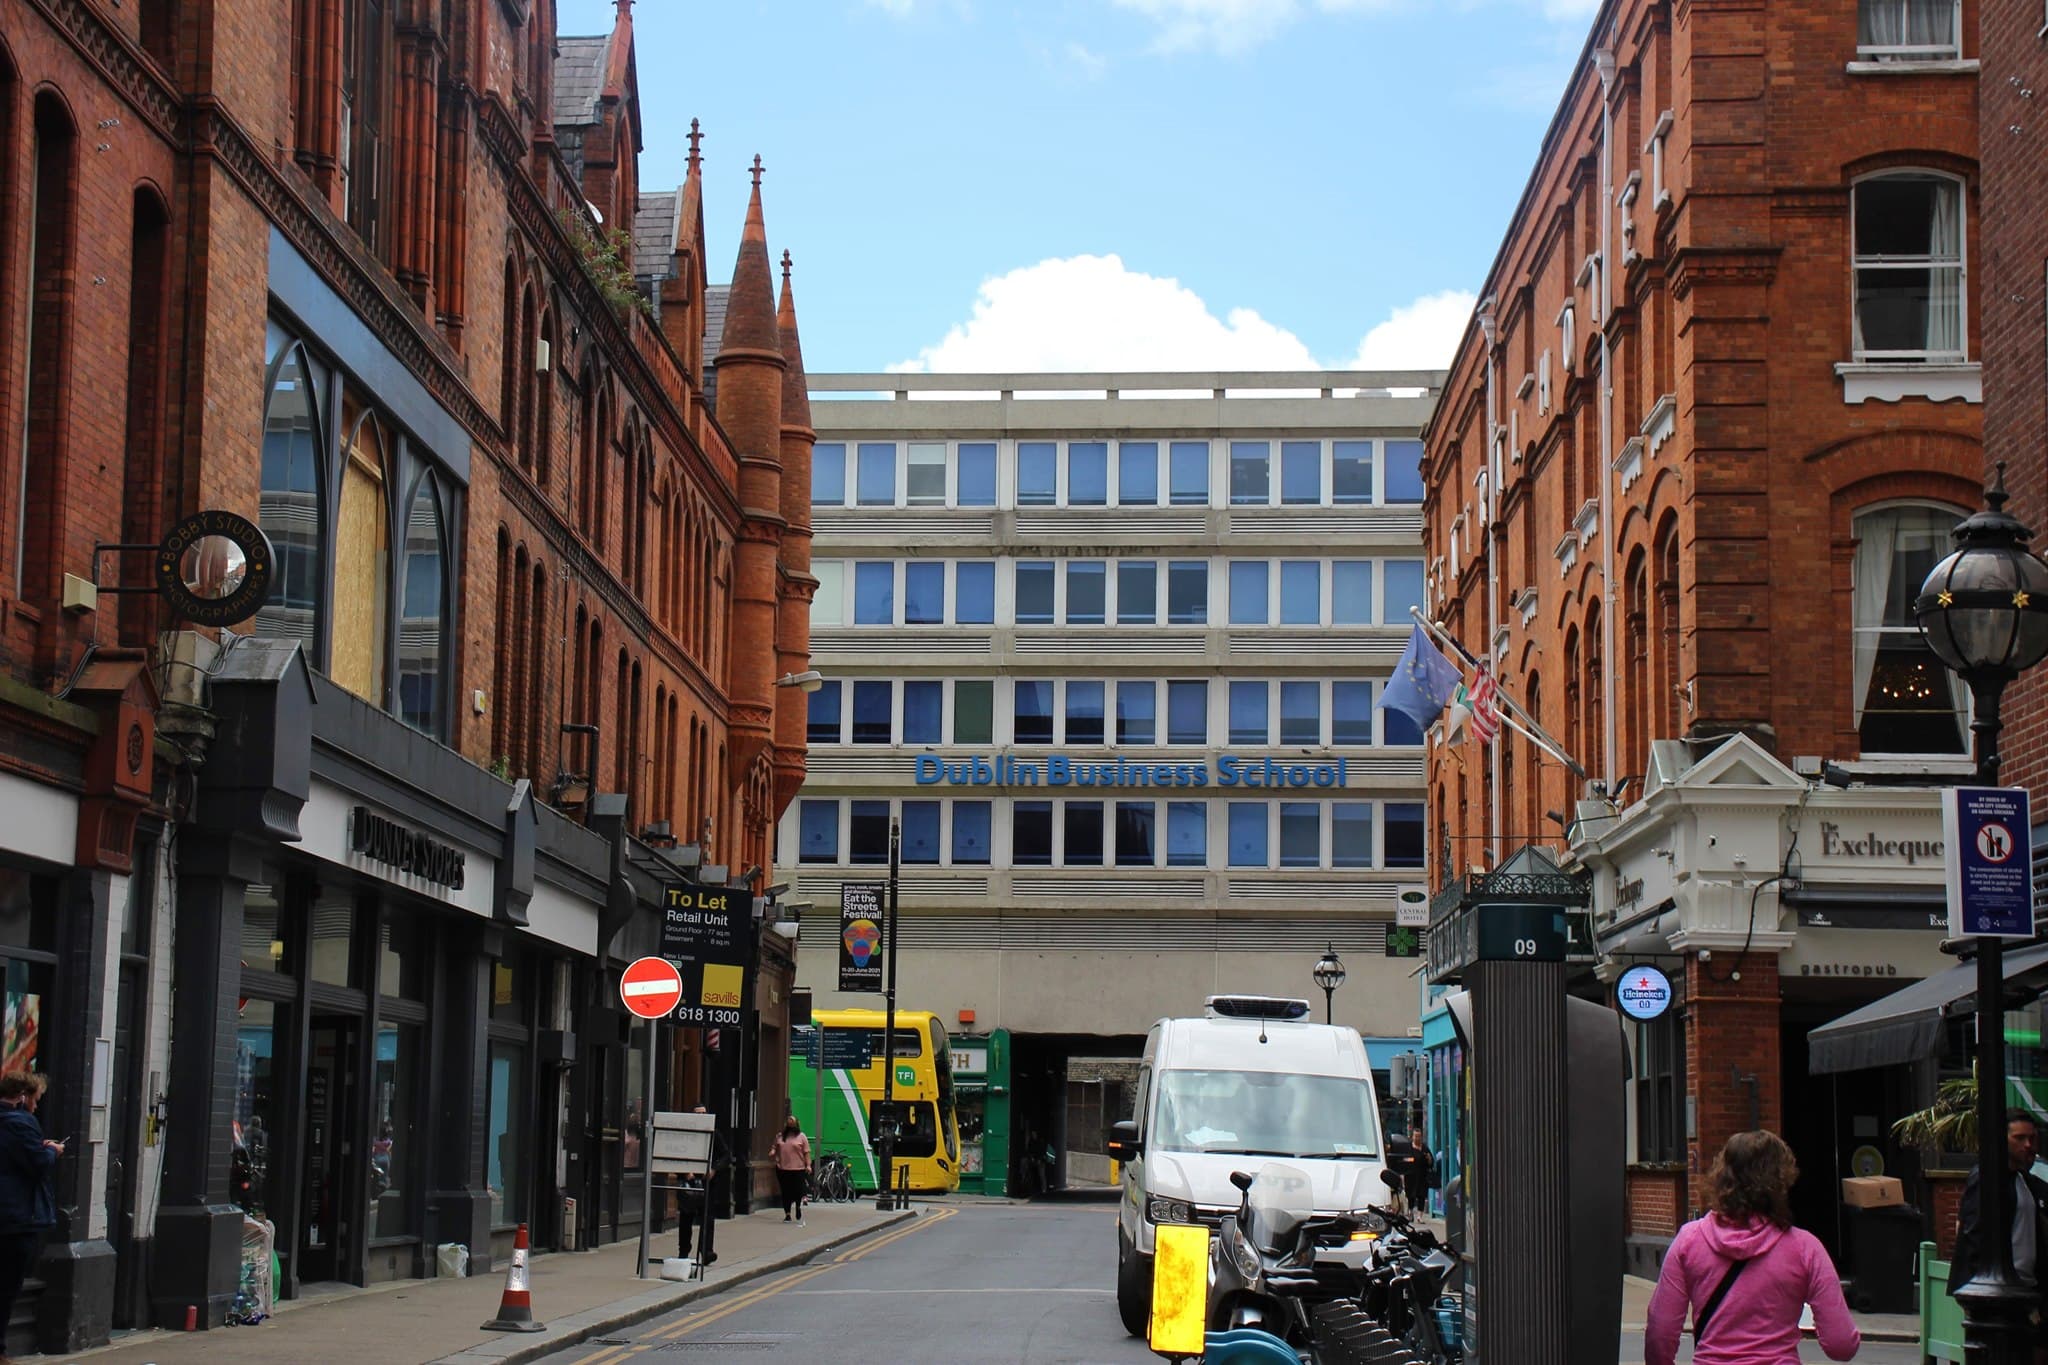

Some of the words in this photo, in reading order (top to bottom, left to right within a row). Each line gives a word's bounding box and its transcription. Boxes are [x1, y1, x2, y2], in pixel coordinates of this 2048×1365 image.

[162, 515, 209, 561] BOBBY
[216, 516, 266, 559] STUDIO
[915, 755, 1038, 785] Dublin
[1048, 755, 1208, 787] Business
[1217, 756, 1347, 788] School
[1820, 821, 1839, 832] The
[353, 806, 416, 873] DUNNES
[414, 831, 465, 890] STORES
[1822, 832, 1945, 865] Excheque
[668, 889, 692, 907] To
[698, 892, 727, 911] Let
[844, 893, 859, 902] Eat
[860, 894, 877, 903] the
[843, 902, 878, 911] Streets
[667, 910, 701, 923] Retail
[704, 913, 728, 926] Unit
[843, 910, 882, 919] Festival!
[665, 925, 687, 934] Ground
[688, 927, 703, 935] Floor
[1514, 939, 1537, 955] 09
[1801, 964, 1897, 977] gastropub
[703, 991, 739, 1005] savills
[1625, 989, 1664, 999] Heineken
[678, 1007, 703, 1021] 618
[707, 1009, 740, 1024] 1300
[897, 1071, 914, 1080] TFI
